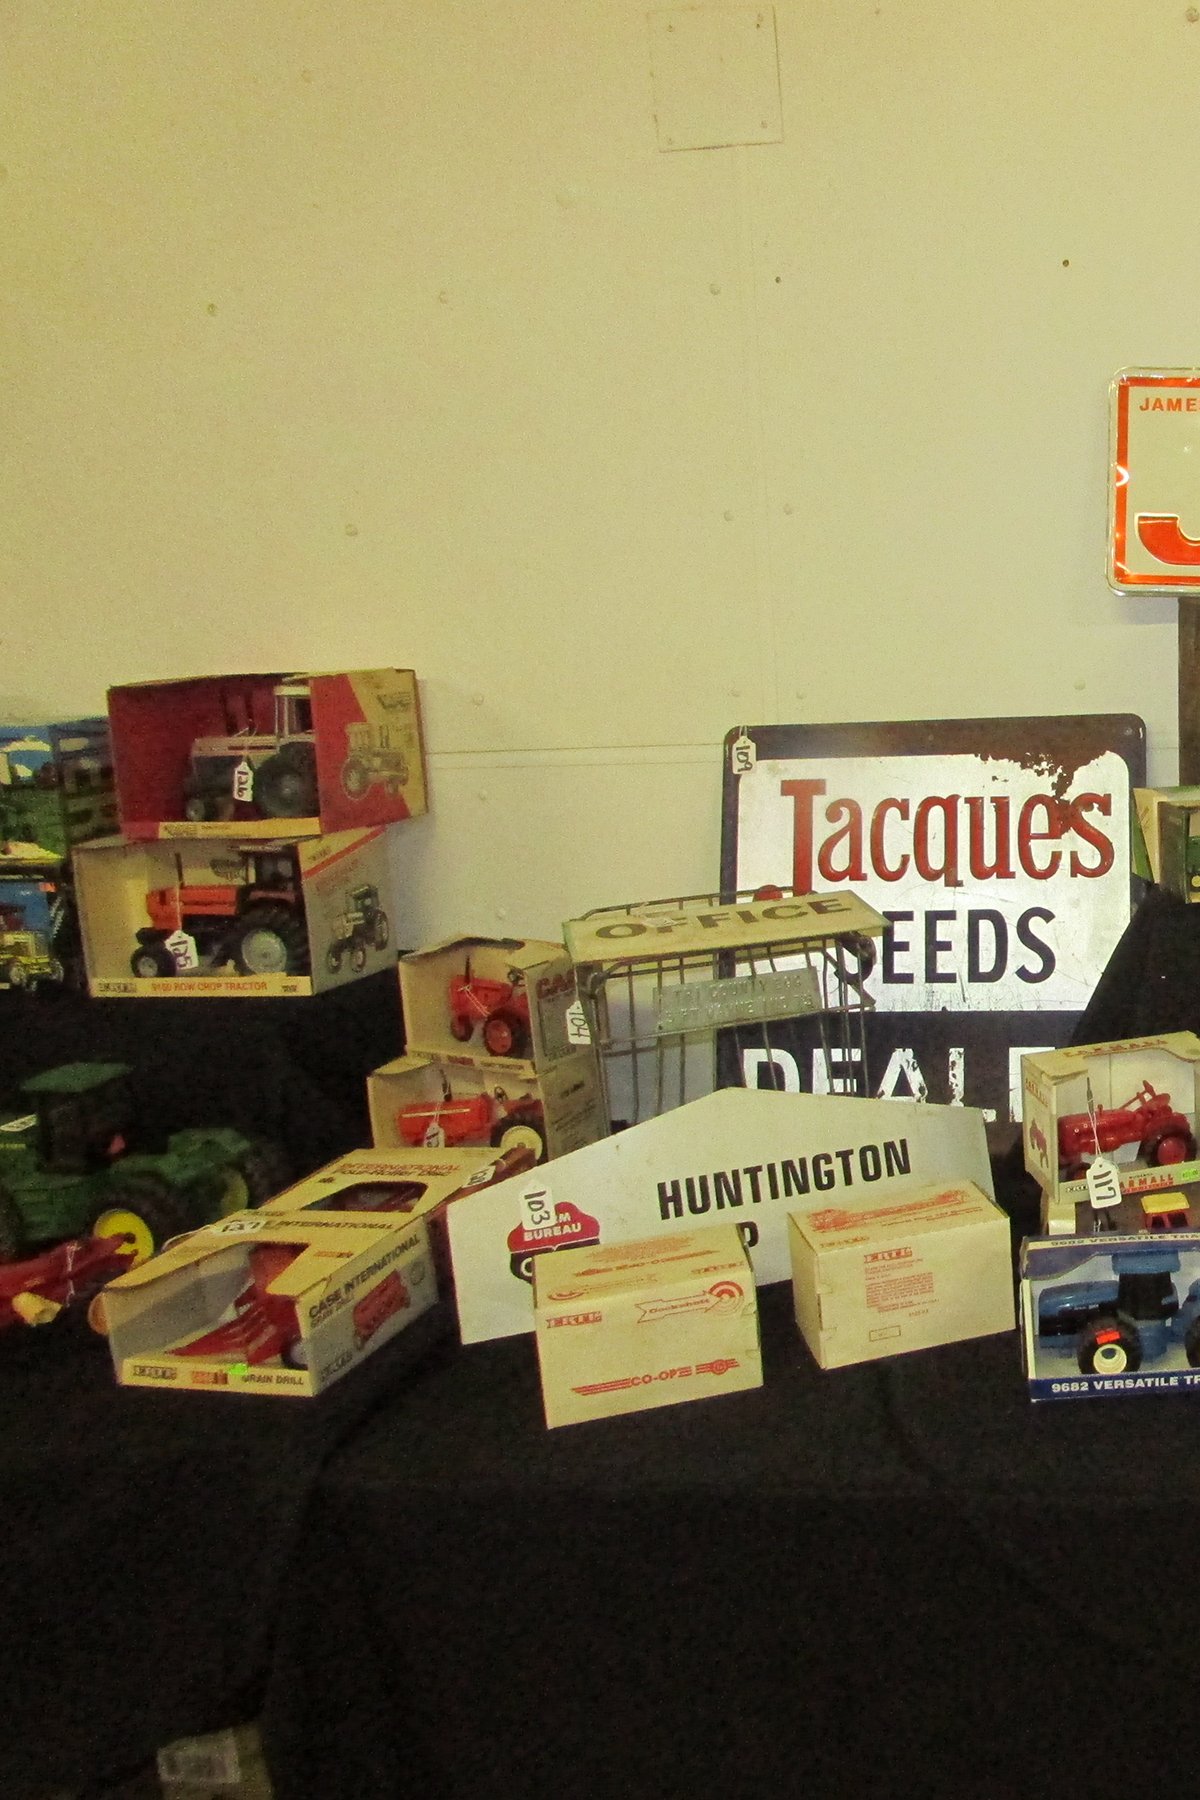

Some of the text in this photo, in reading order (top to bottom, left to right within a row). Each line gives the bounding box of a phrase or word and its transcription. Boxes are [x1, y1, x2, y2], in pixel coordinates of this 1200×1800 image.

[223, 982, 268, 991] TRACTOR
[656, 1138, 912, 1221] HUNTINGTON
[1092, 1170, 1117, 1201] 117
[1119, 1173, 1174, 1189] ARMALL
[523, 1189, 551, 1226] 103
[278, 1220, 396, 1230] INTERNATIONAL
[522, 1222, 582, 1242] BUREAU
[308, 1287, 342, 1318] CASE
[342, 1232, 422, 1295] INTERNATIONAL
[275, 1373, 304, 1386] DRILL
[629, 1368, 678, 1387] CO-OP
[1051, 1381, 1090, 1393] 9682
[1092, 1374, 1180, 1391] VERSATILE
